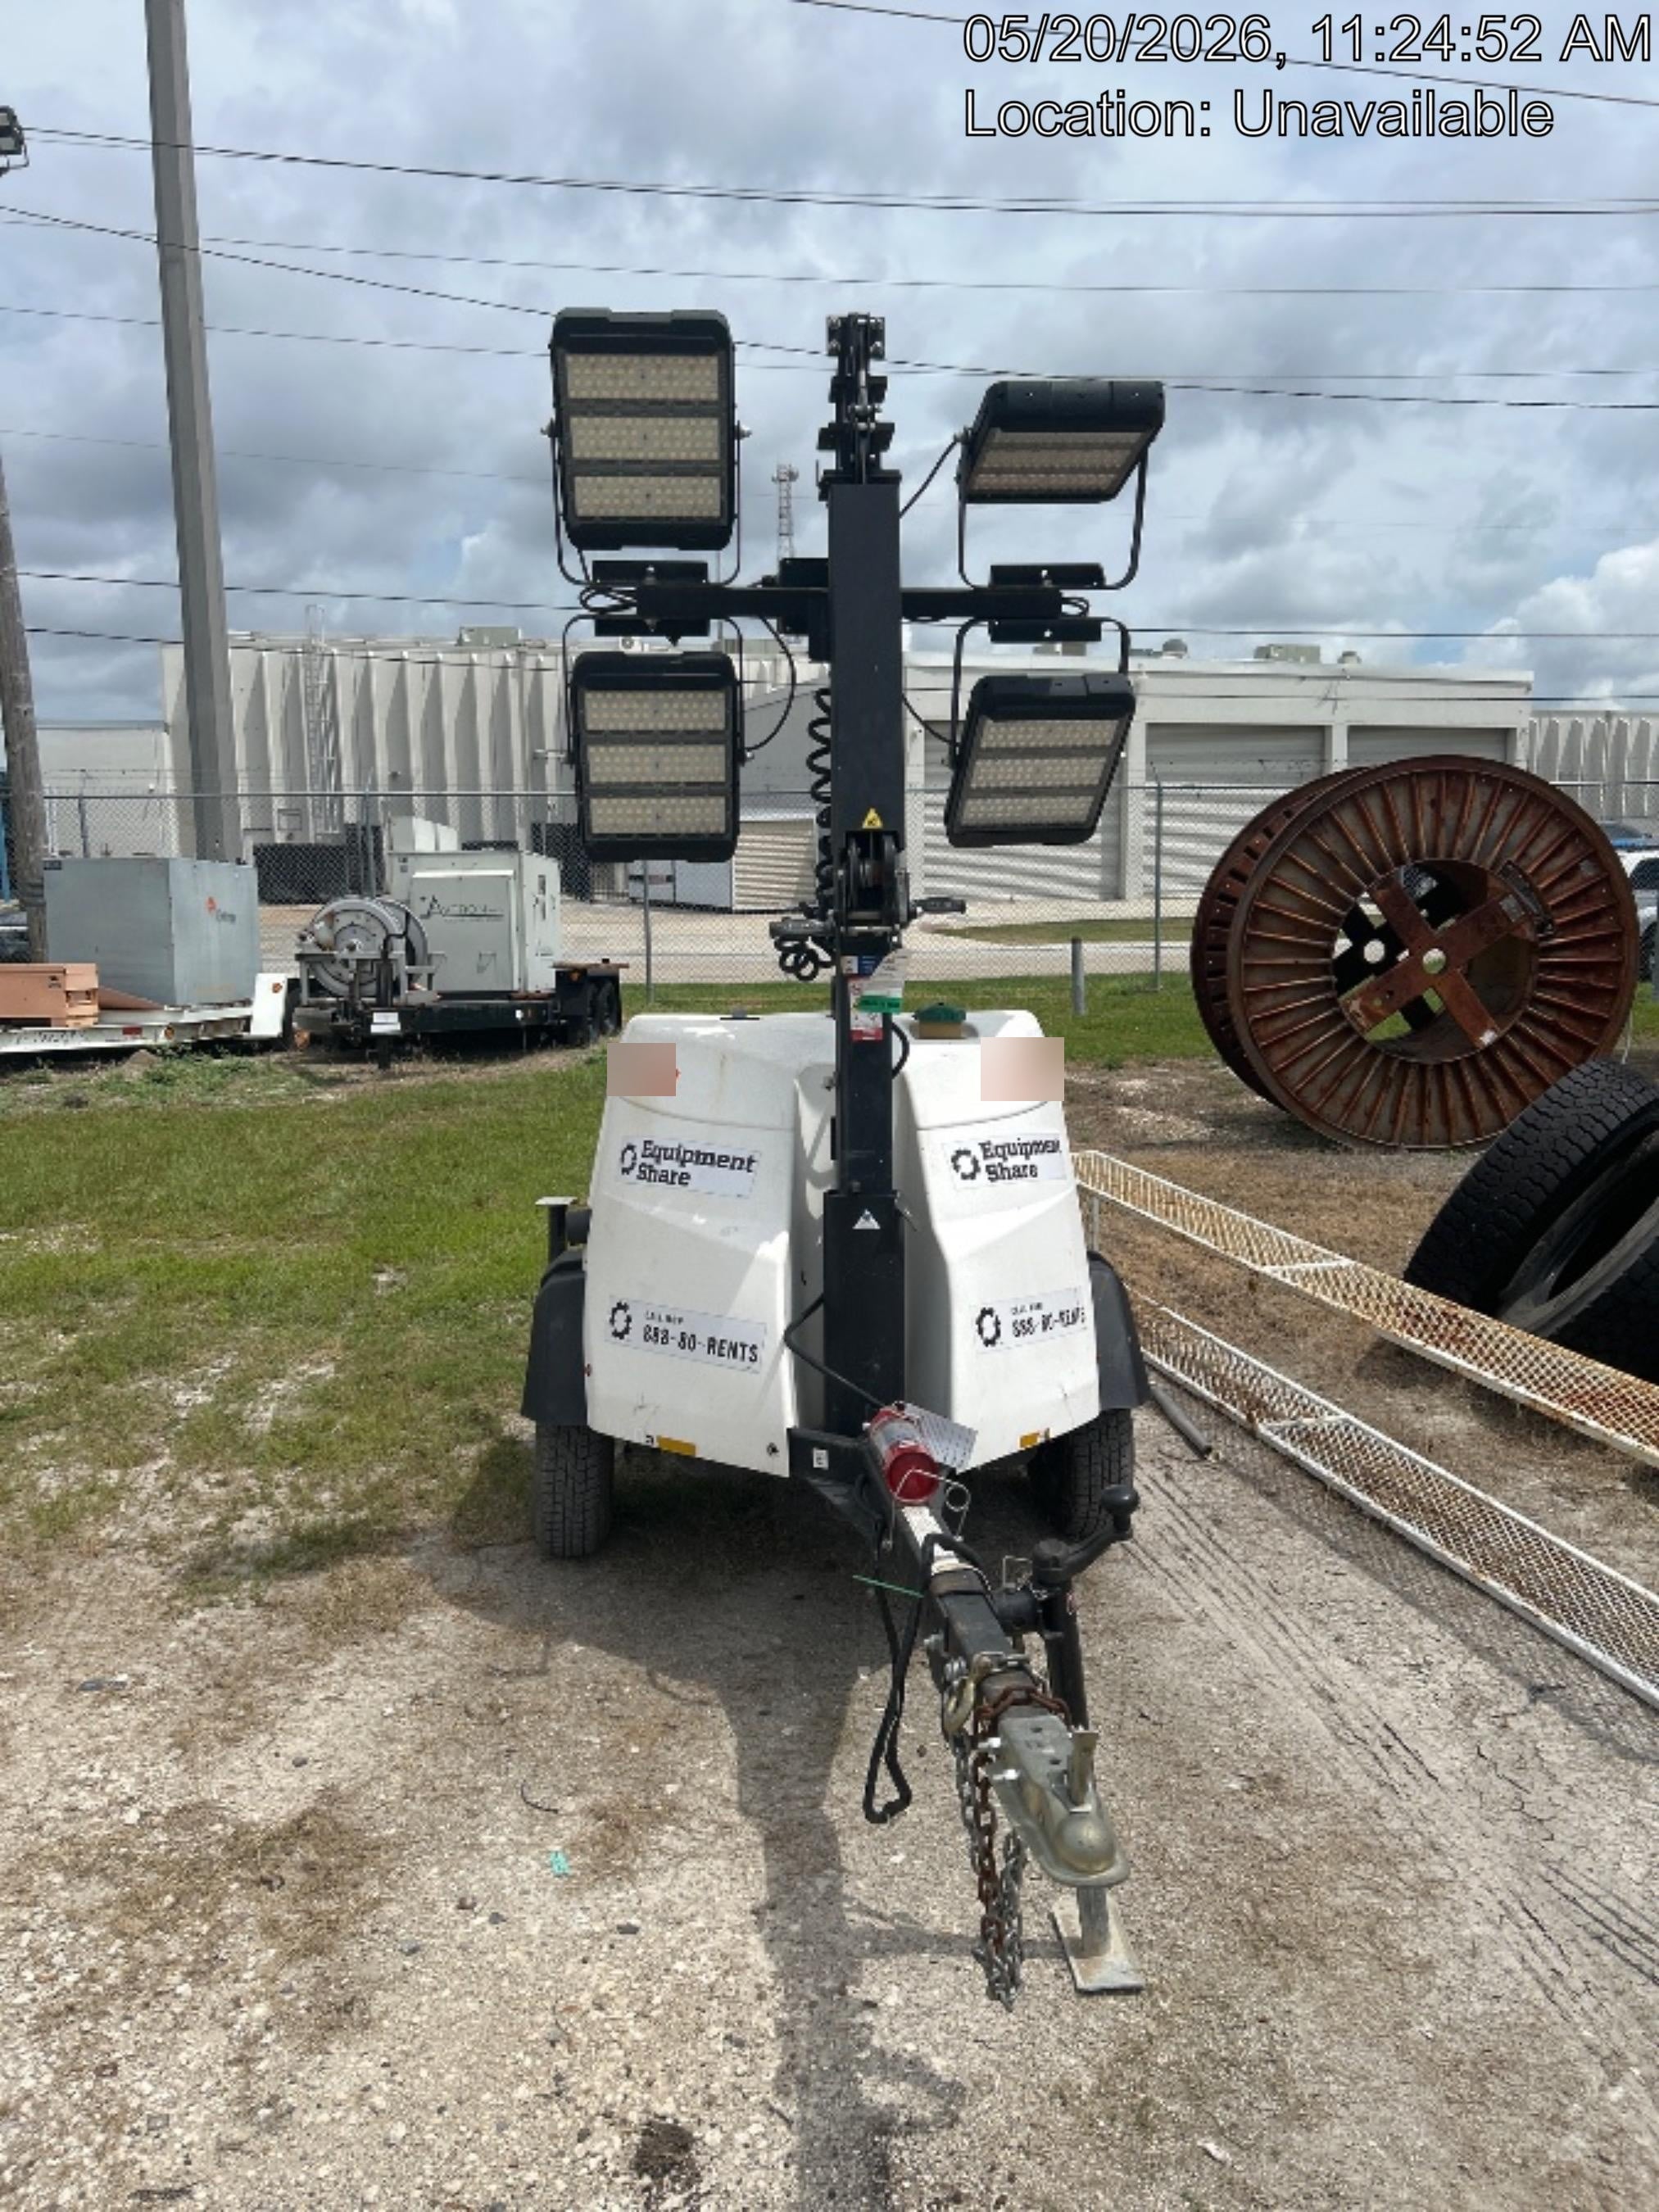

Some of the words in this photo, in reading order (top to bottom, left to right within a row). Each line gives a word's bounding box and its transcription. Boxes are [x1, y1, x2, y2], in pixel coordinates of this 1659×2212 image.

[641, 1140, 755, 1172] Equipment
[978, 1137, 1062, 1161] Equipmen
[637, 1163, 691, 1185] Share
[985, 1162, 1038, 1182] Share
